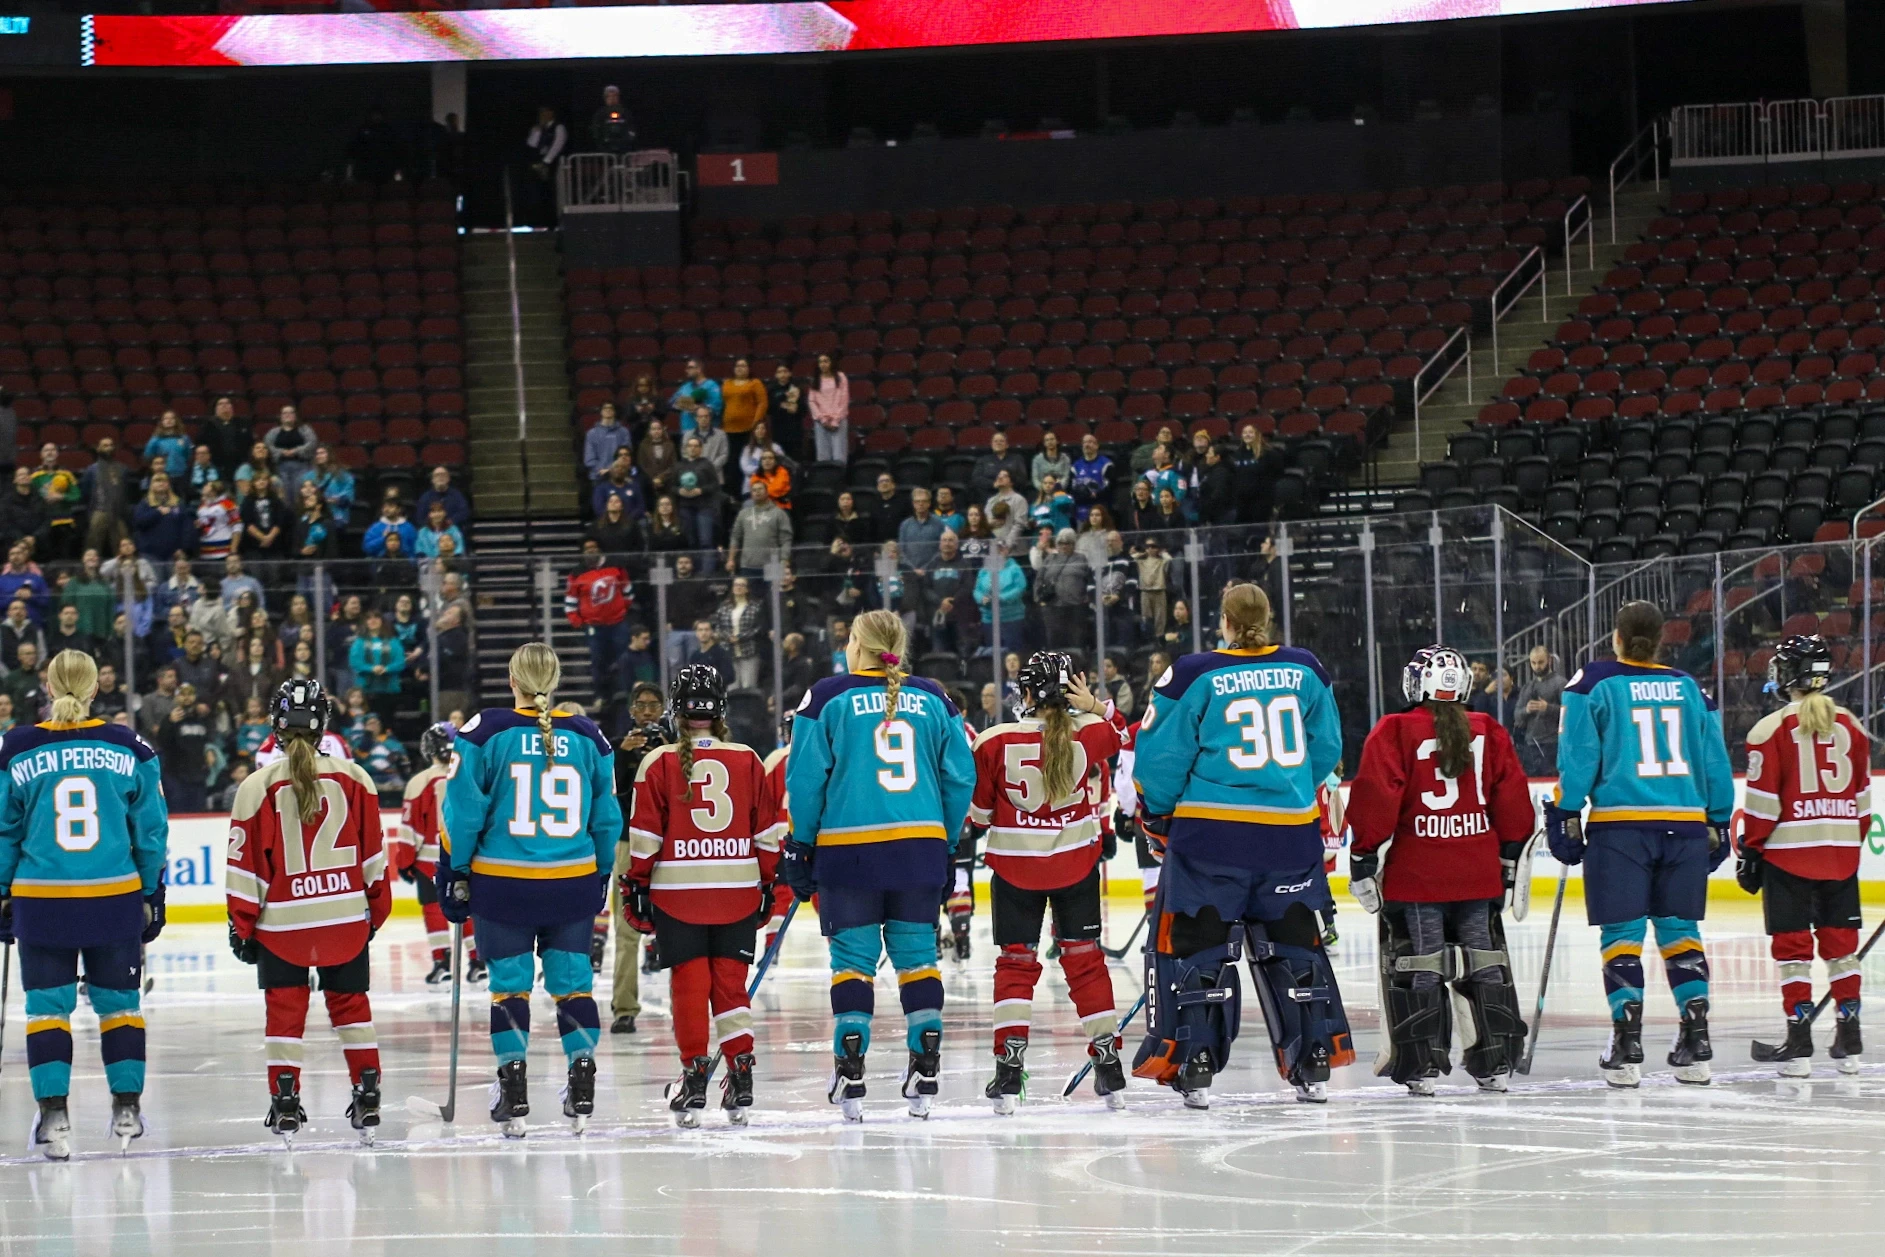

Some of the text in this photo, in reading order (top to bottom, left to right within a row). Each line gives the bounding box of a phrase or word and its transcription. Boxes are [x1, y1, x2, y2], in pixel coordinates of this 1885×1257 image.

[730, 158, 746, 181] 1
[851, 691, 927, 716] ELDDGE
[1212, 668, 1303, 696] SCHROEDER
[1629, 681, 1684, 702] ROQUE
[521, 733, 569, 757] LEIS
[874, 719, 918, 793] 9
[1225, 694, 1305, 770] 30
[1631, 706, 1690, 778] 11
[1790, 722, 1853, 794] 13
[11, 747, 136, 786] NYLÉN PERSSON
[689, 758, 734, 833] 3
[1004, 740, 1088, 814] 52
[1416, 734, 1487, 811] 31
[54, 775, 100, 852] 8
[275, 778, 357, 877] 12
[508, 762, 582, 838] 19
[674, 838, 751, 859] BOOROM
[291, 872, 351, 898] GOLDA
[1274, 878, 1313, 894] CCM
[1148, 967, 1156, 1028] CCM
